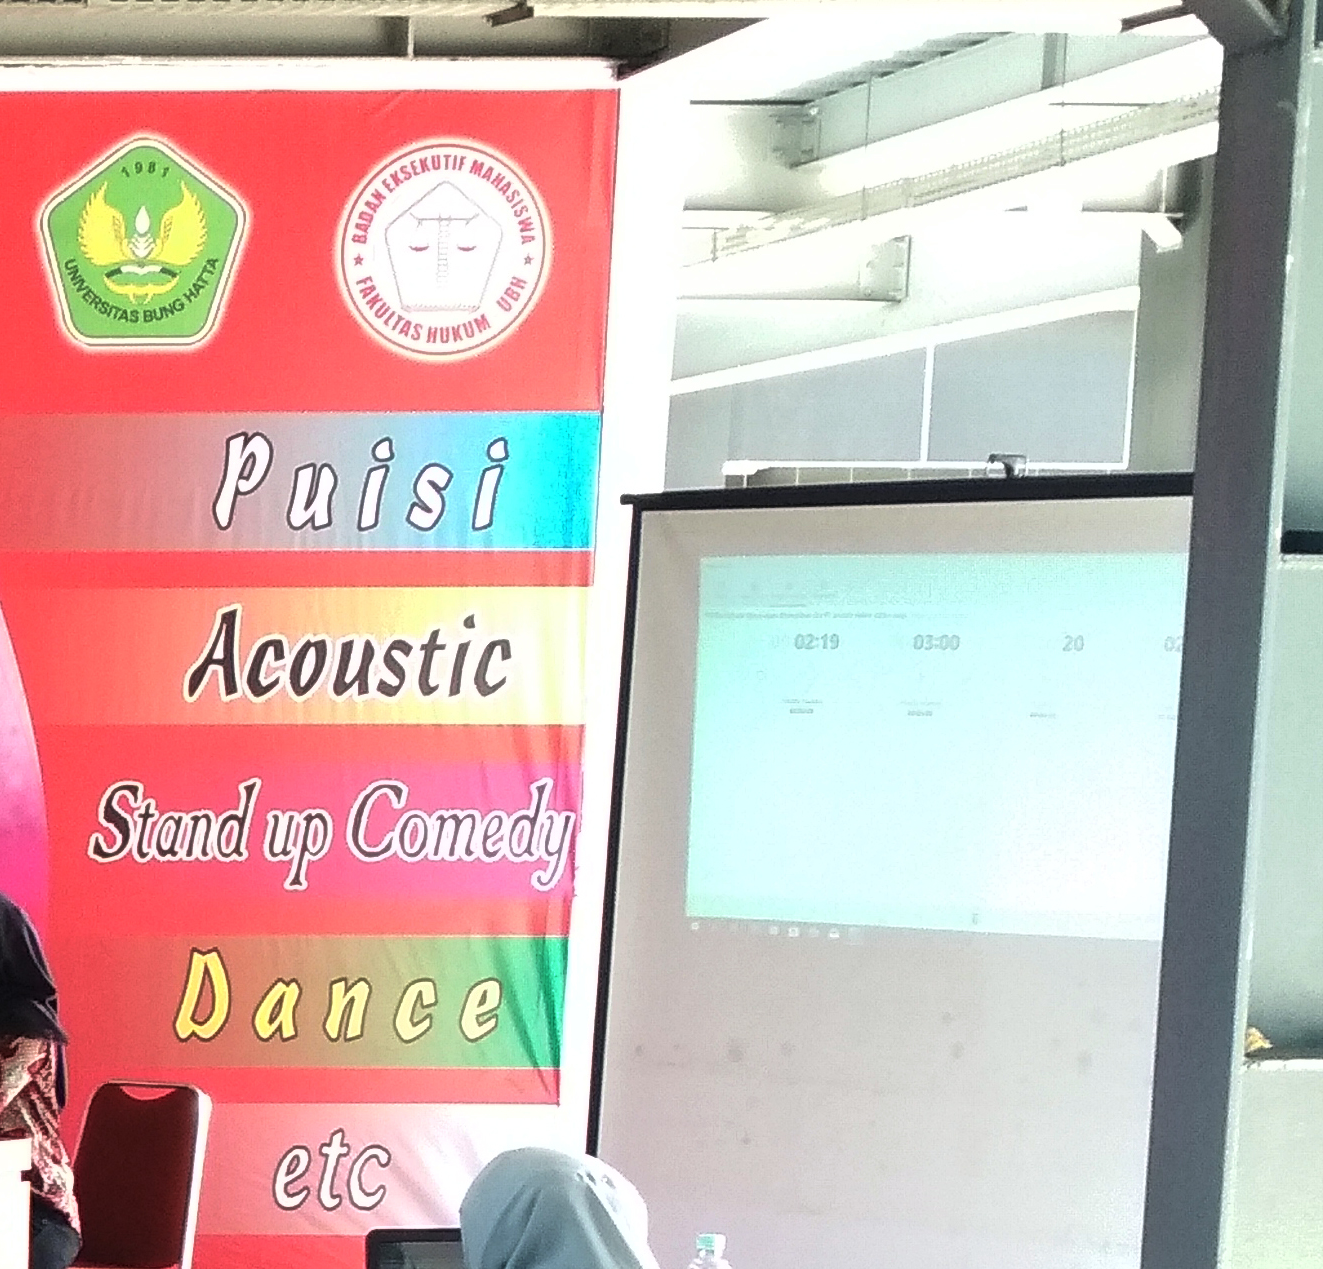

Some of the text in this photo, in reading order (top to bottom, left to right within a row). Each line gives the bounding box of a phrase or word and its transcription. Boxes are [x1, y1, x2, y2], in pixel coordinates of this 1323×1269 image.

[121, 162, 170, 178] 1981
[351, 154, 536, 245] BADAN EKSEKUTIF MAHASISWA
[65, 257, 219, 323] UNIVERSITAS BUNG HATTA
[356, 276, 528, 343] FAKULTAS HUKUM UBH
[212, 432, 510, 531] Puisi
[187, 605, 513, 700] Acoustic
[89, 778, 575, 890] Stand up Comedy
[174, 947, 502, 1044] Dance
[273, 1128, 392, 1211] etc
